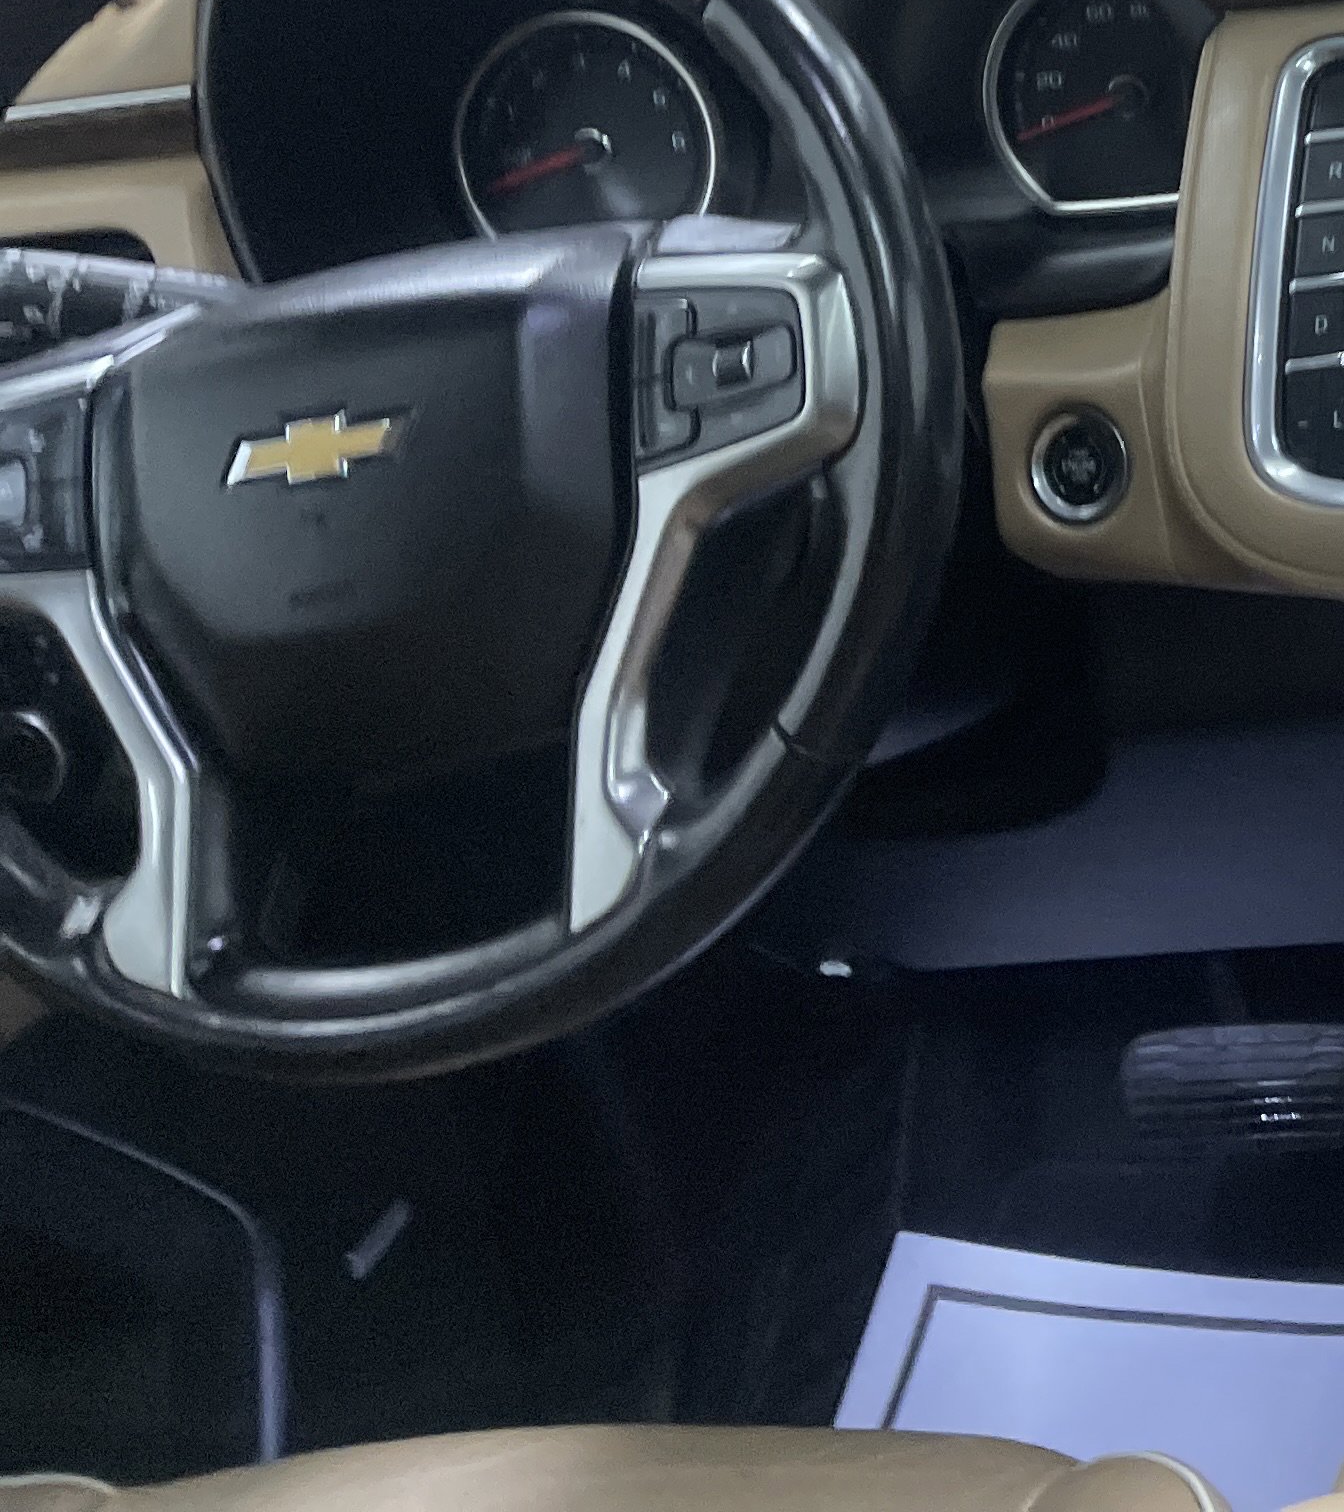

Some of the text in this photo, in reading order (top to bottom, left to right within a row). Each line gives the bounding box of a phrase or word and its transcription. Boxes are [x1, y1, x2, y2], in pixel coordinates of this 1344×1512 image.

[1329, 160, 1343, 179] R
[1322, 236, 1335, 253] N
[1314, 315, 1328, 335] D
